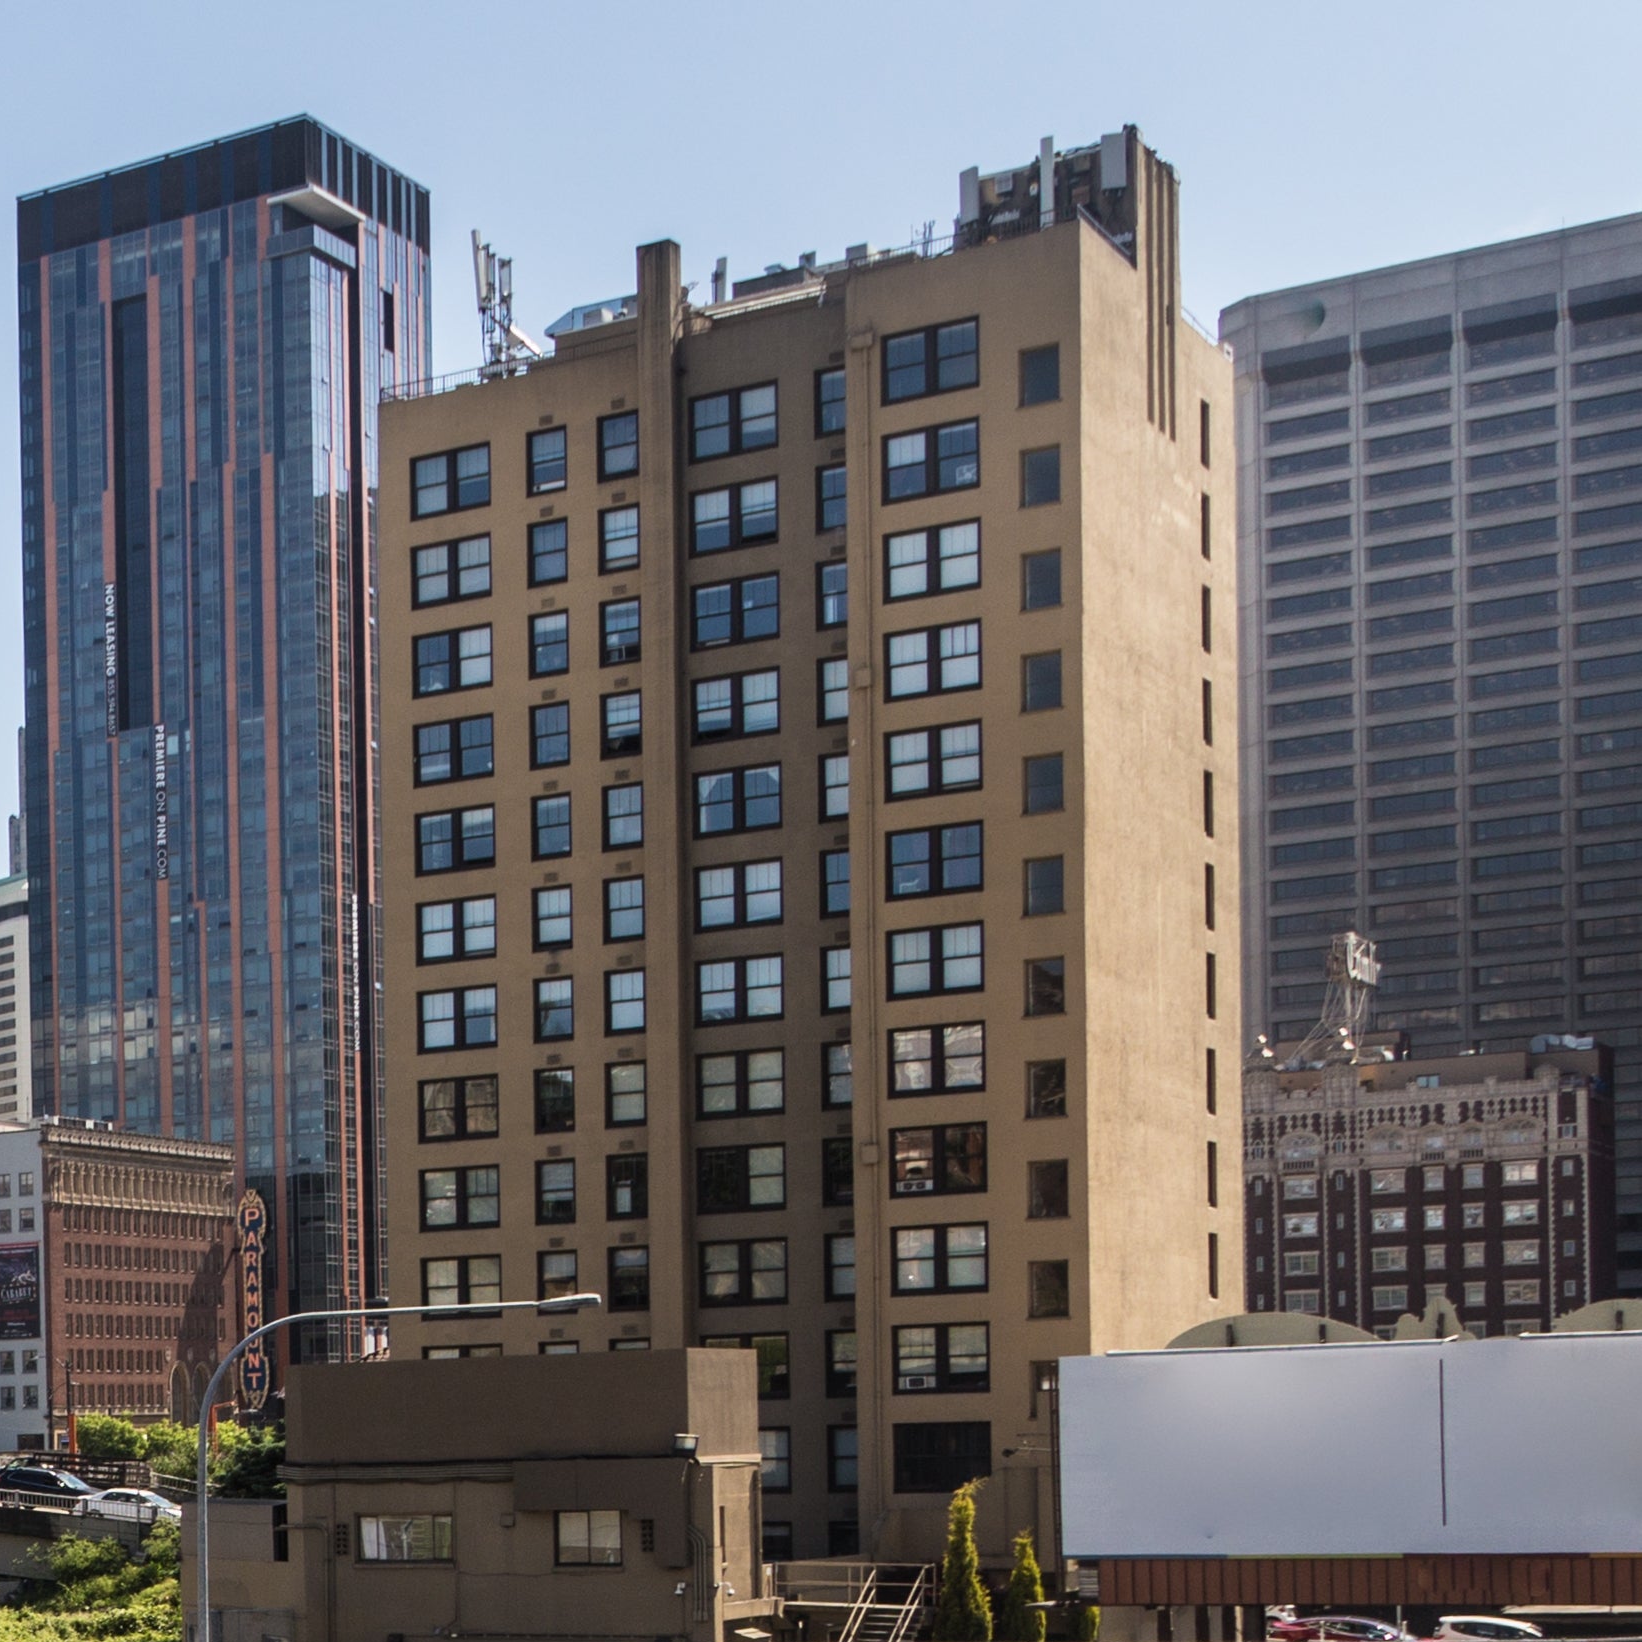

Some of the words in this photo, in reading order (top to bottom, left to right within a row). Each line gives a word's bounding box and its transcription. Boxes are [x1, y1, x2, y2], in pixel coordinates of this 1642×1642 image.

[105, 584, 115, 618] NOW
[106, 621, 116, 677] LEASING
[155, 724, 166, 788] PREMIERE
[156, 791, 166, 812] ON
